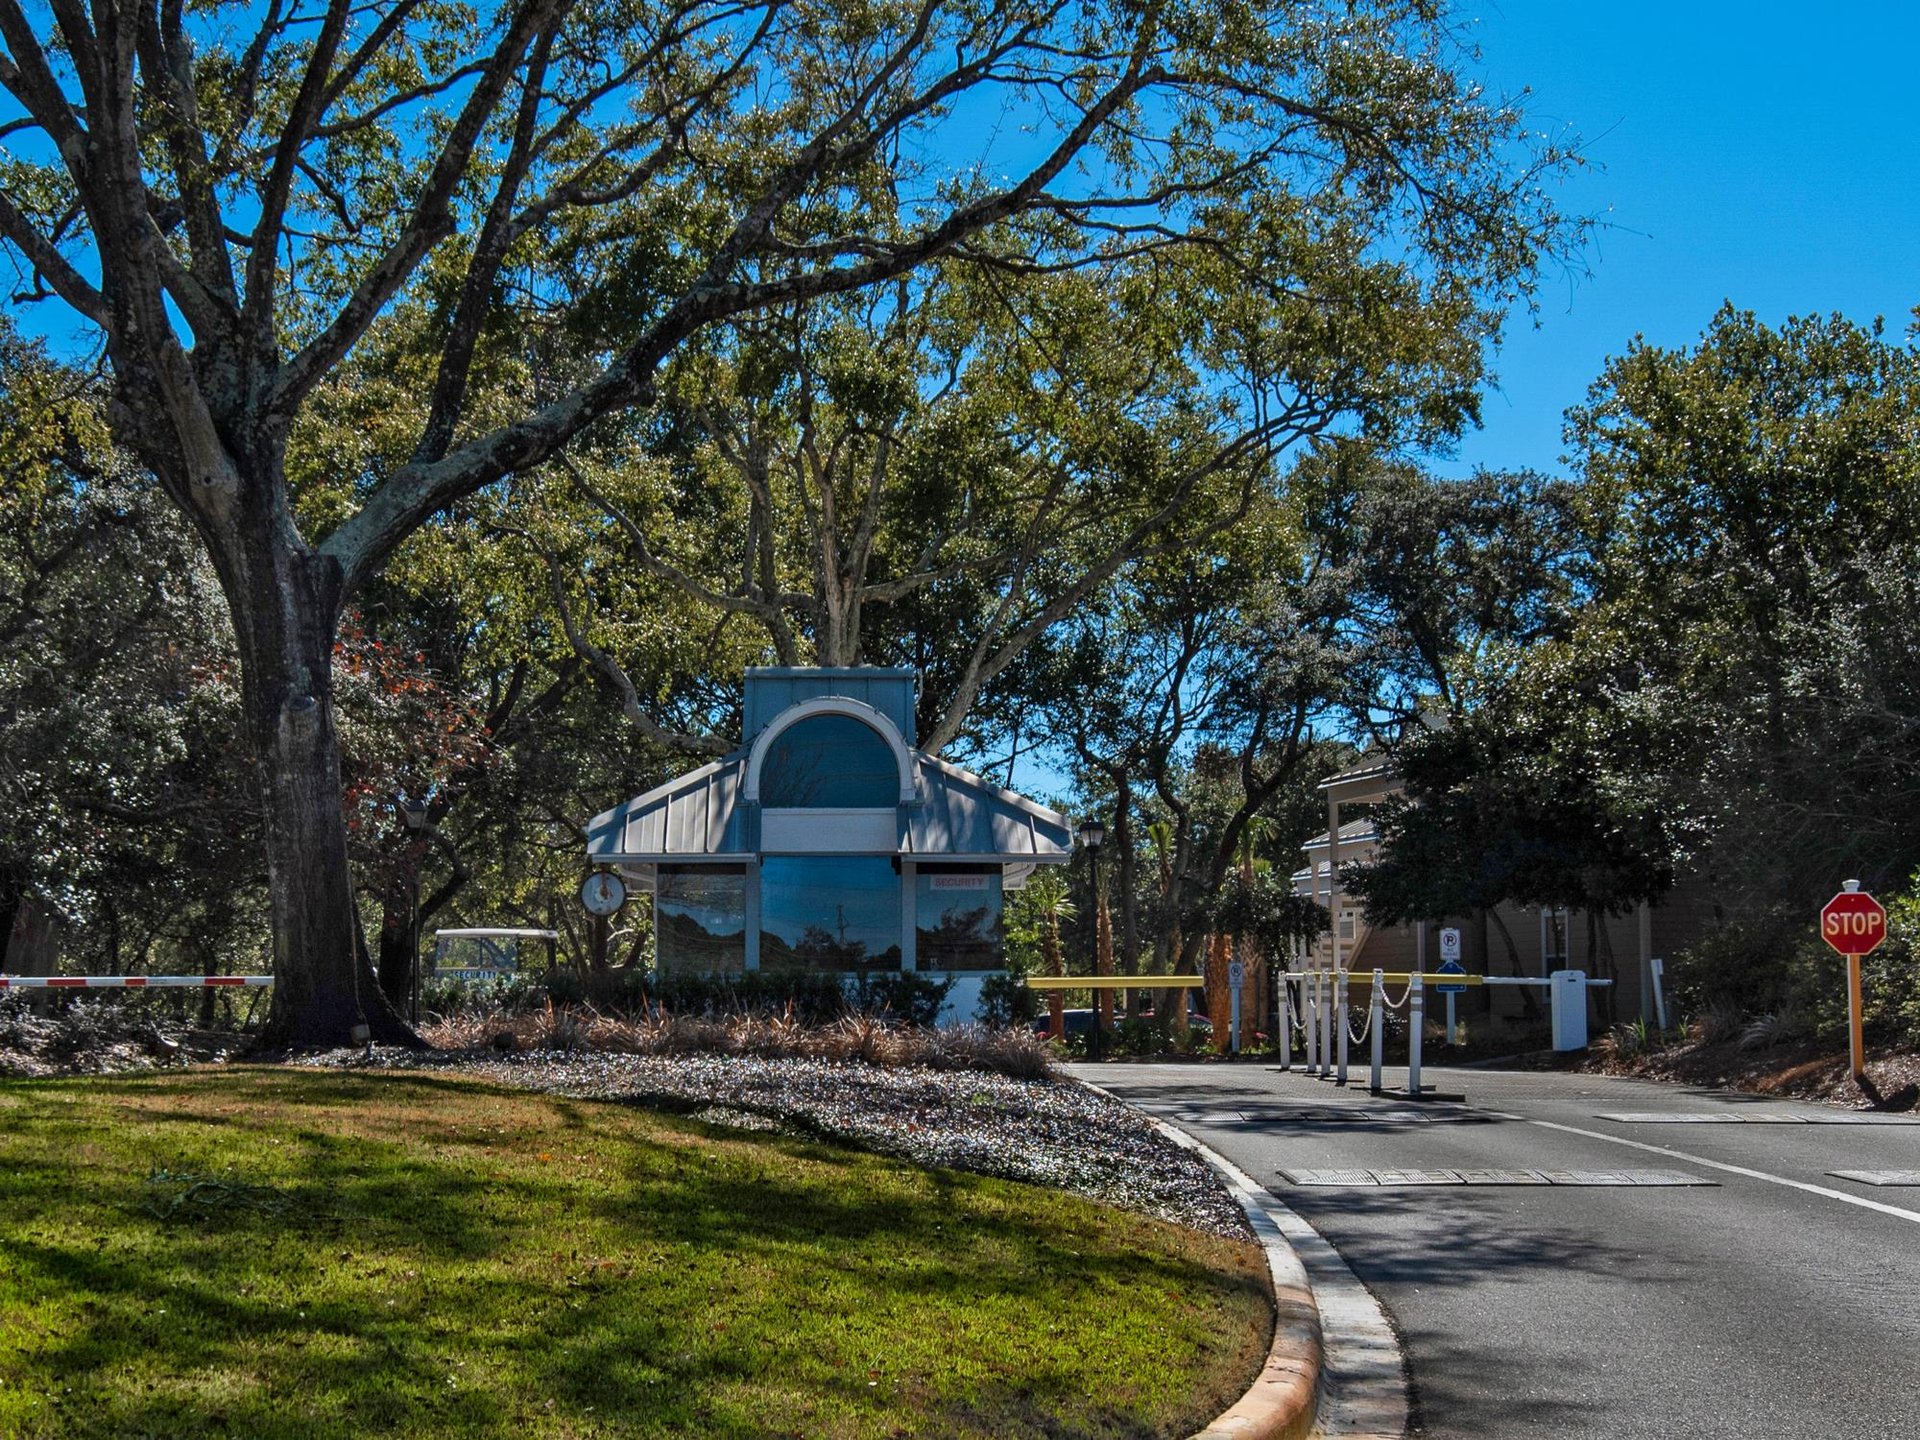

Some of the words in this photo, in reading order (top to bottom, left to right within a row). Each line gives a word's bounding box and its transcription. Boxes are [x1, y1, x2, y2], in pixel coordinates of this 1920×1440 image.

[935, 877, 984, 886] SECURITY
[1826, 912, 1881, 935] STOP
[454, 971, 496, 979] SECURITY
